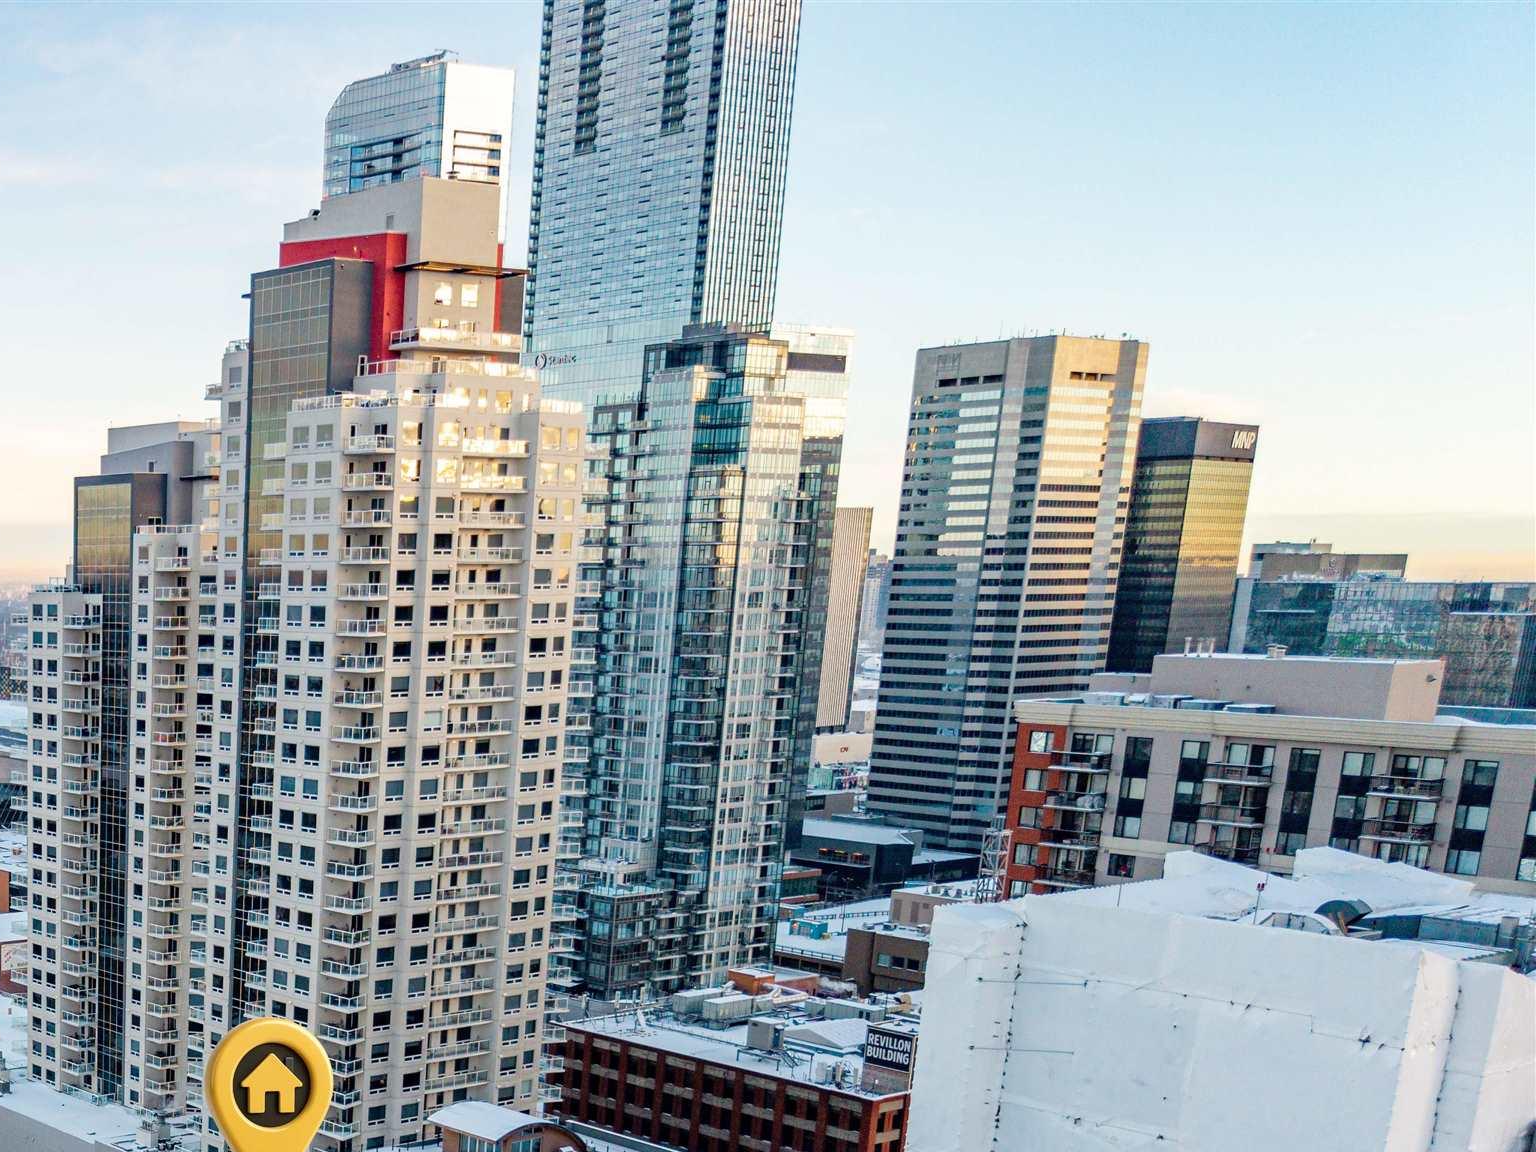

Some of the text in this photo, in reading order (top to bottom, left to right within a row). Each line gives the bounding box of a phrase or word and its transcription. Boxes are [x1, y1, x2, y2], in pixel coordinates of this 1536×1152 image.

[1231, 430, 1256, 449] MNP
[868, 1033, 912, 1052] REVILLON
[866, 1045, 910, 1065] BUILDING
